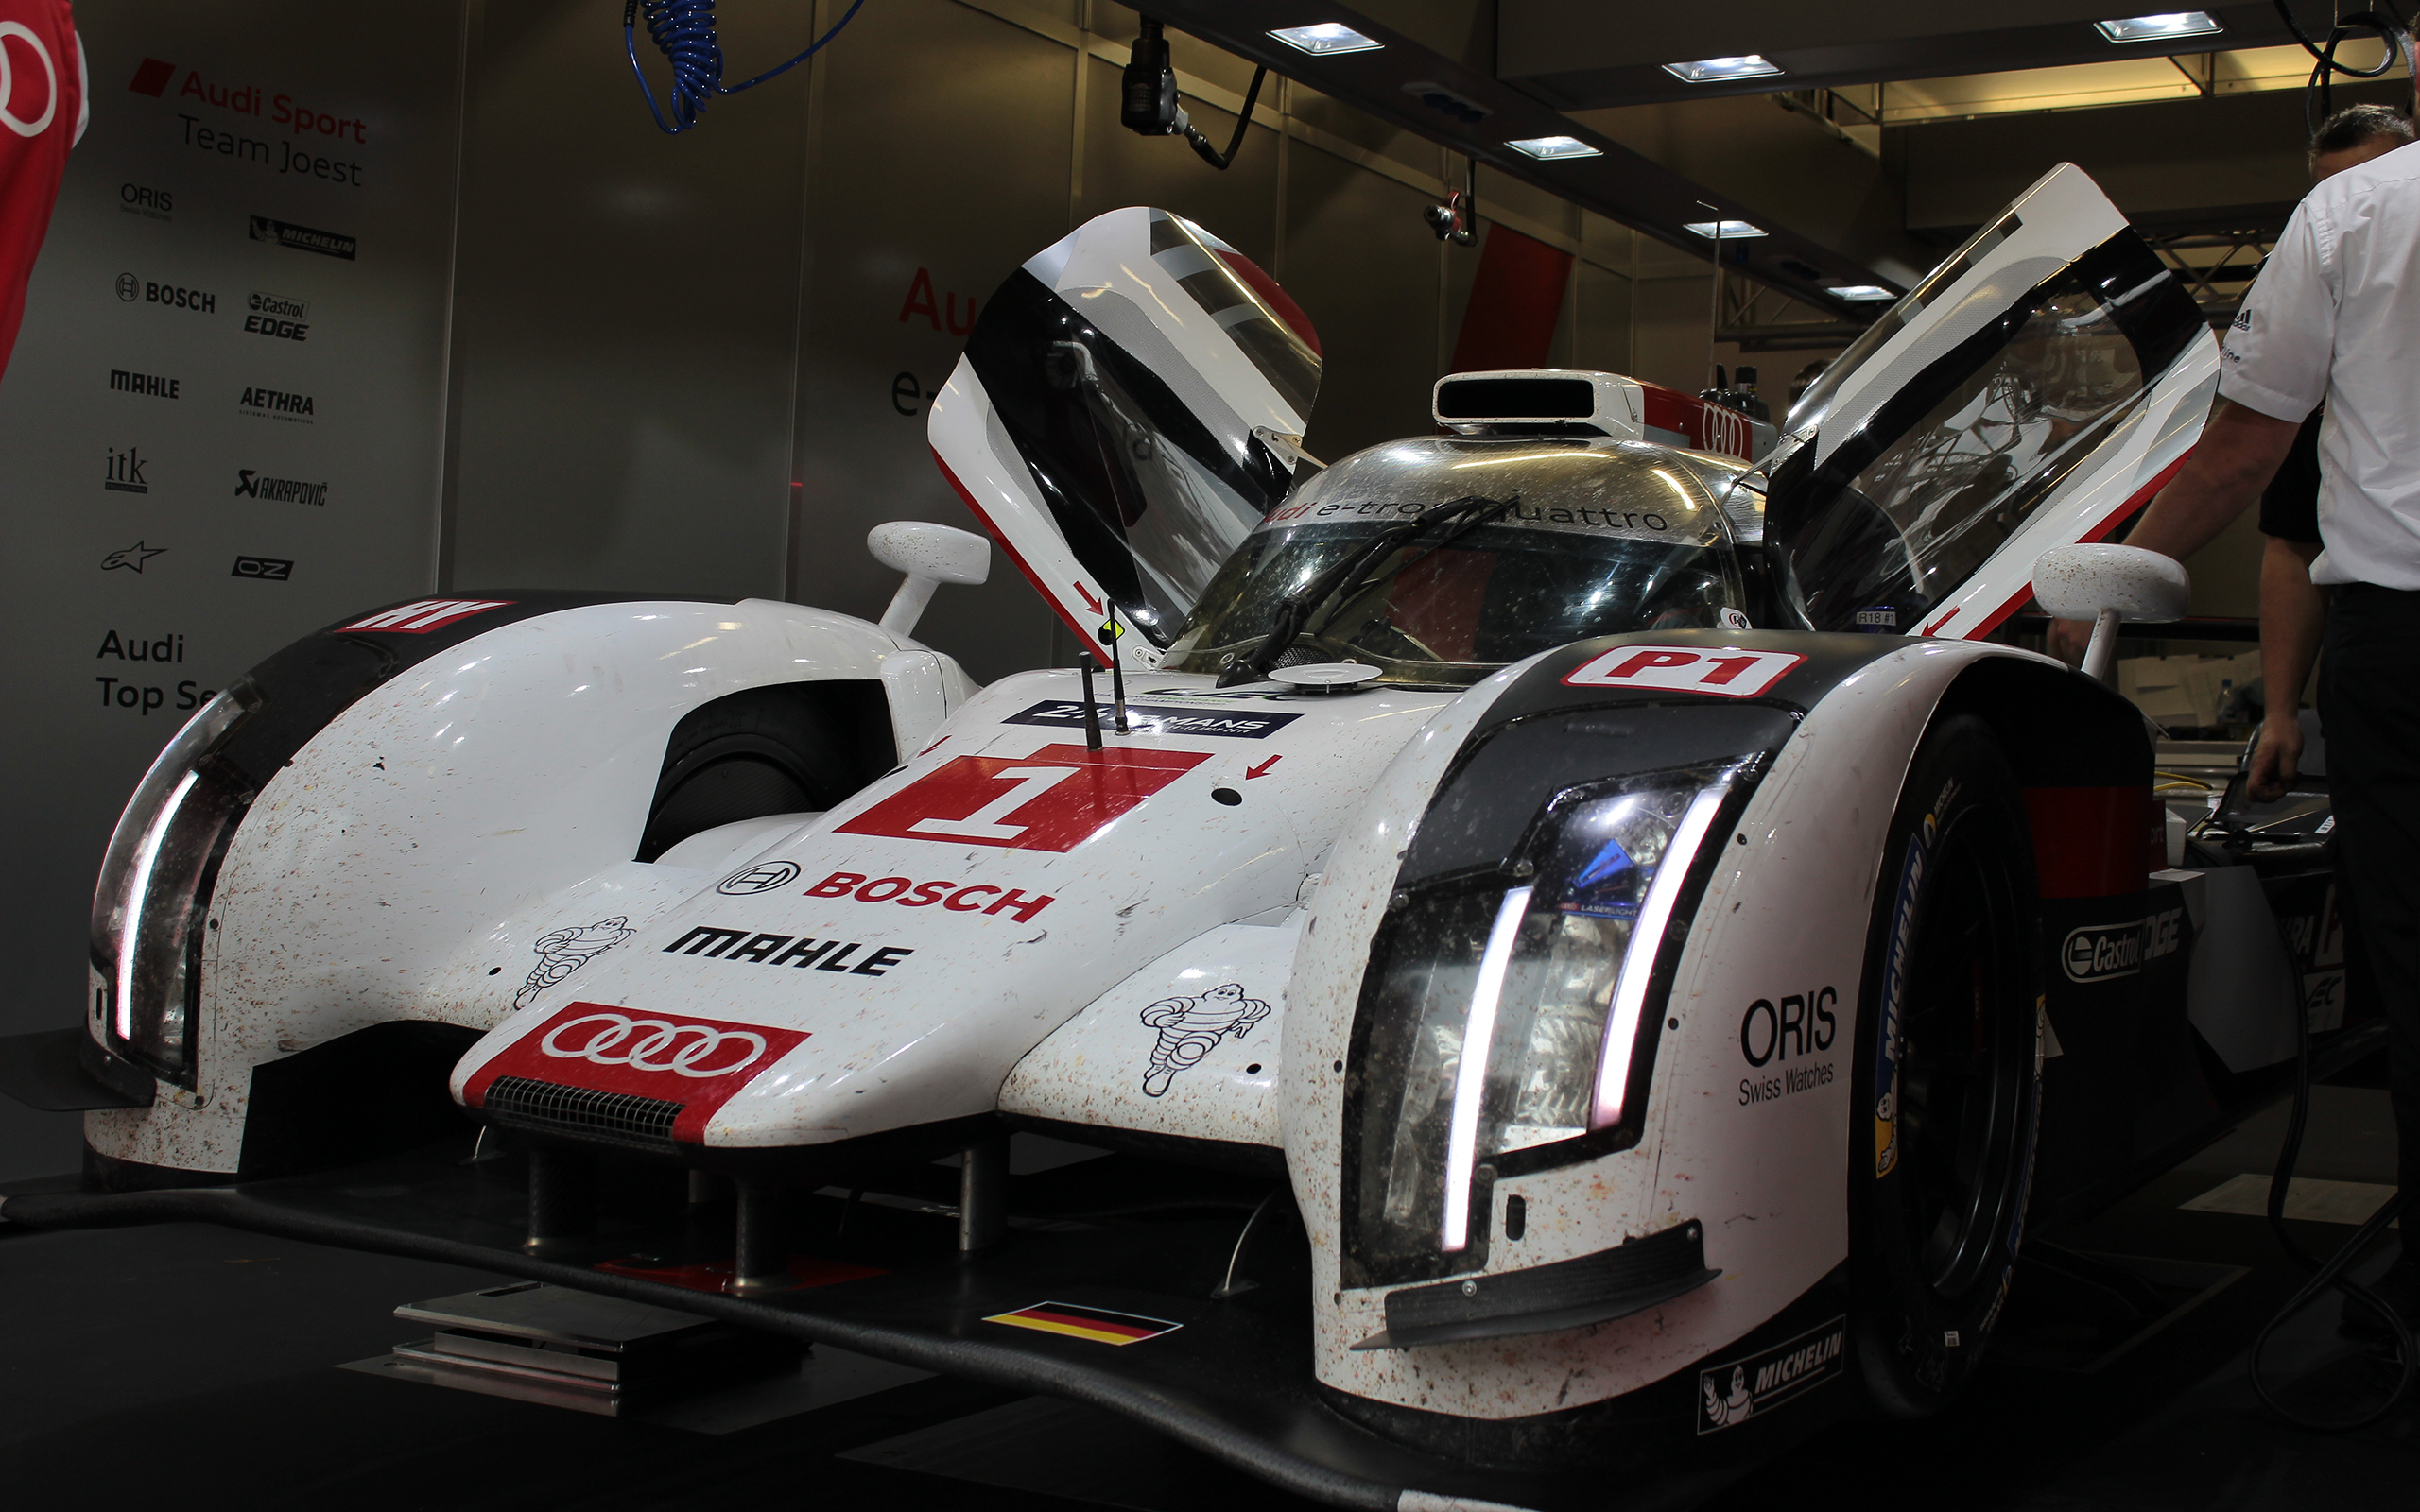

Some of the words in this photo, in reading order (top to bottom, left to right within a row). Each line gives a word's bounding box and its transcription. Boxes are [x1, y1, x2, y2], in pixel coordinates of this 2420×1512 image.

[179, 70, 261, 117] Audi
[271, 94, 367, 144] Sport
[178, 113, 269, 164] Team
[279, 140, 362, 187] Joest
[120, 182, 173, 212] ORIS
[281, 227, 354, 253] MICHELIN
[146, 281, 216, 315] BOSCH
[262, 296, 304, 318] Castrol
[243, 315, 310, 342] EDGE
[110, 369, 180, 400] MAHLE
[239, 387, 314, 416] AETHRA
[106, 446, 148, 485] itk
[1316, 501, 1448, 517] e-tro
[1858, 612, 1881, 624] R18
[96, 629, 184, 663] Audi
[1604, 650, 1763, 685] P1
[95, 676, 164, 715] Top
[1161, 716, 1270, 730] MANS
[906, 765, 1082, 840] 1
[803, 870, 1056, 924] BOSCH
[660, 925, 917, 977] MAHLE
[1884, 850, 1924, 1063] MICHELIN
[2093, 930, 2141, 972] Castrol
[2144, 906, 2184, 961] DGE
[1740, 985, 1838, 1069] ORIS
[1738, 1074, 1782, 1107] Swiss
[1785, 1060, 1835, 1095] Watches
[1754, 1330, 1843, 1395] MICHELIN
